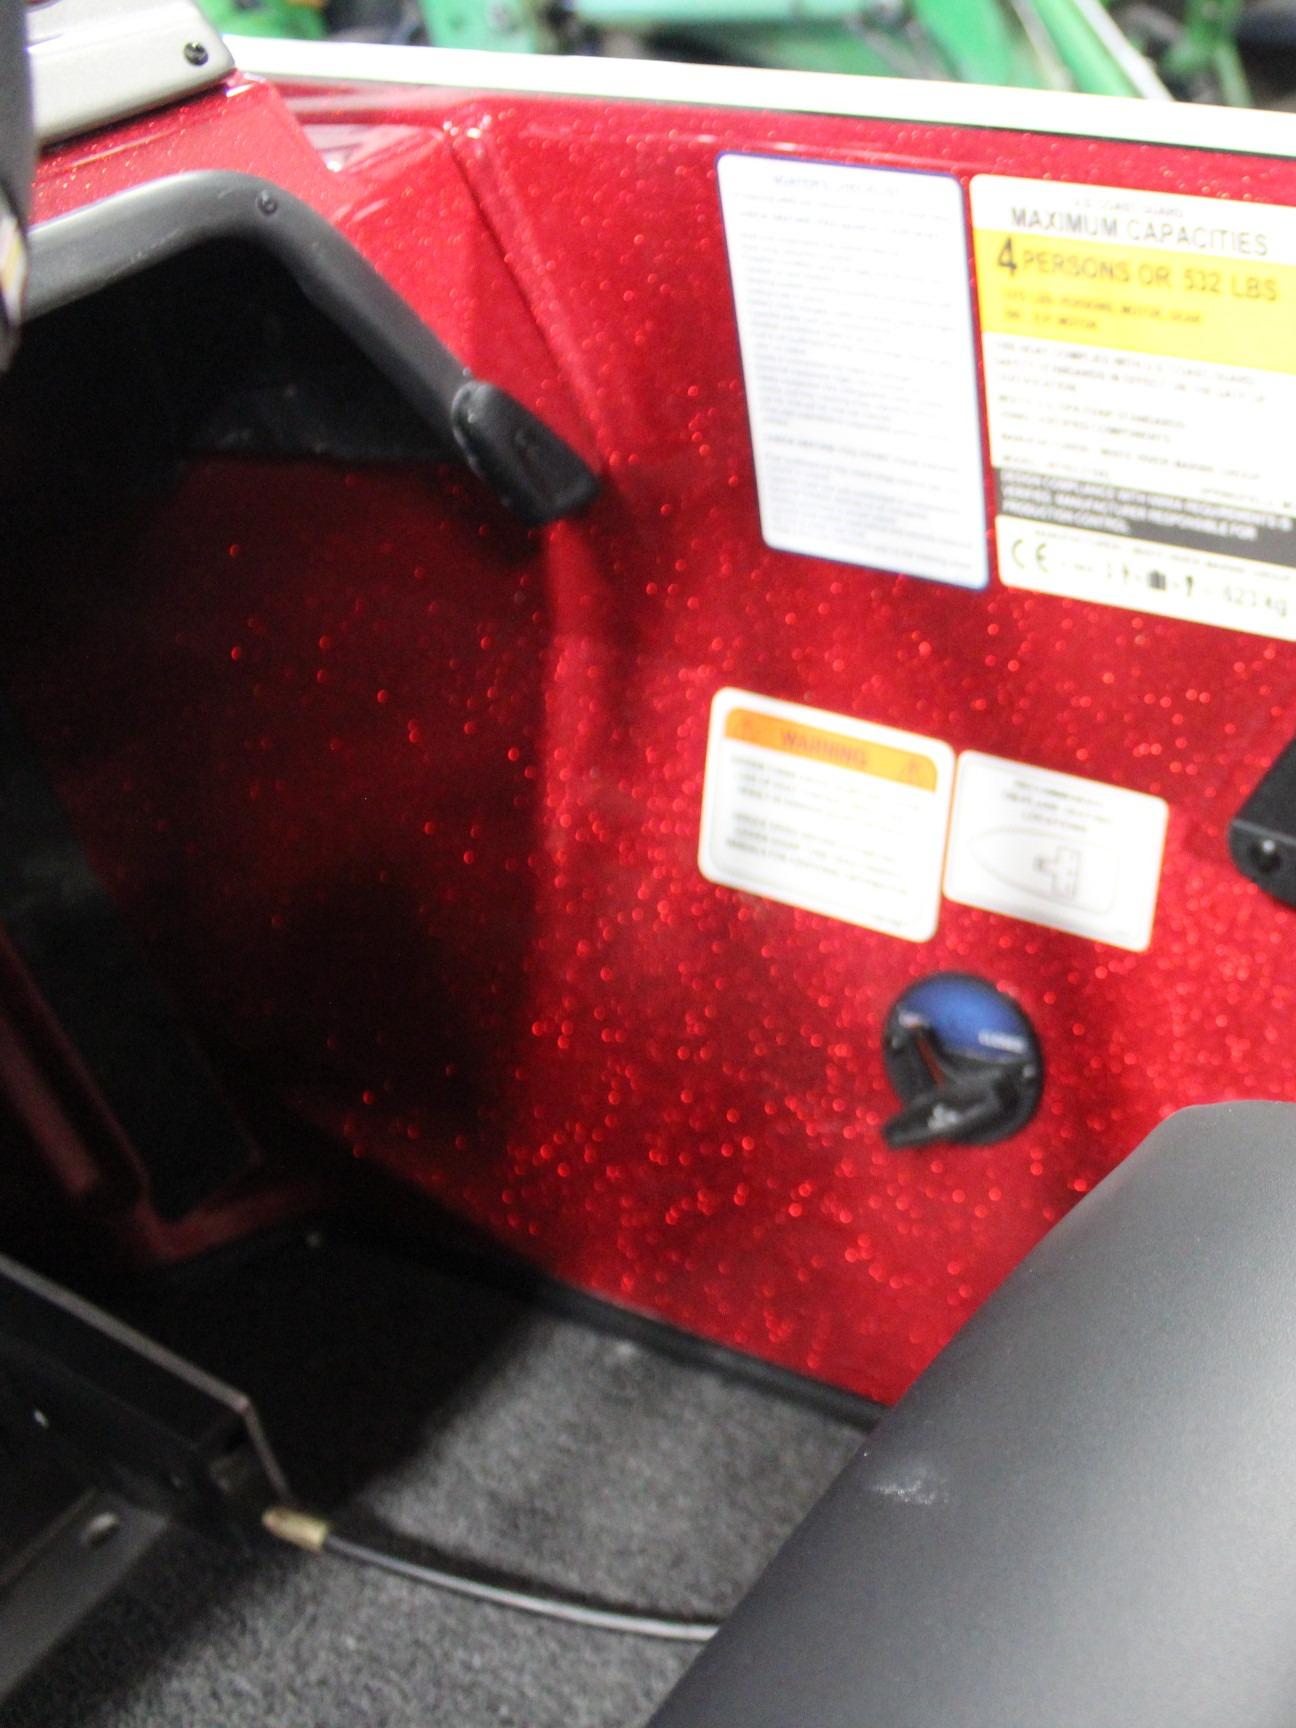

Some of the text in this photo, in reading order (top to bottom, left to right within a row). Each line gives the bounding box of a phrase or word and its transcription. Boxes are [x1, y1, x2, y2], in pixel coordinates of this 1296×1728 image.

[1010, 207, 1269, 257] MAXIMUM CAPACITIES
[997, 237, 1018, 277] 4
[1022, 249, 1131, 284] PERSONS
[1137, 264, 1171, 288] OR
[1230, 275, 1278, 303] LBS
[782, 732, 868, 767] WARNING
